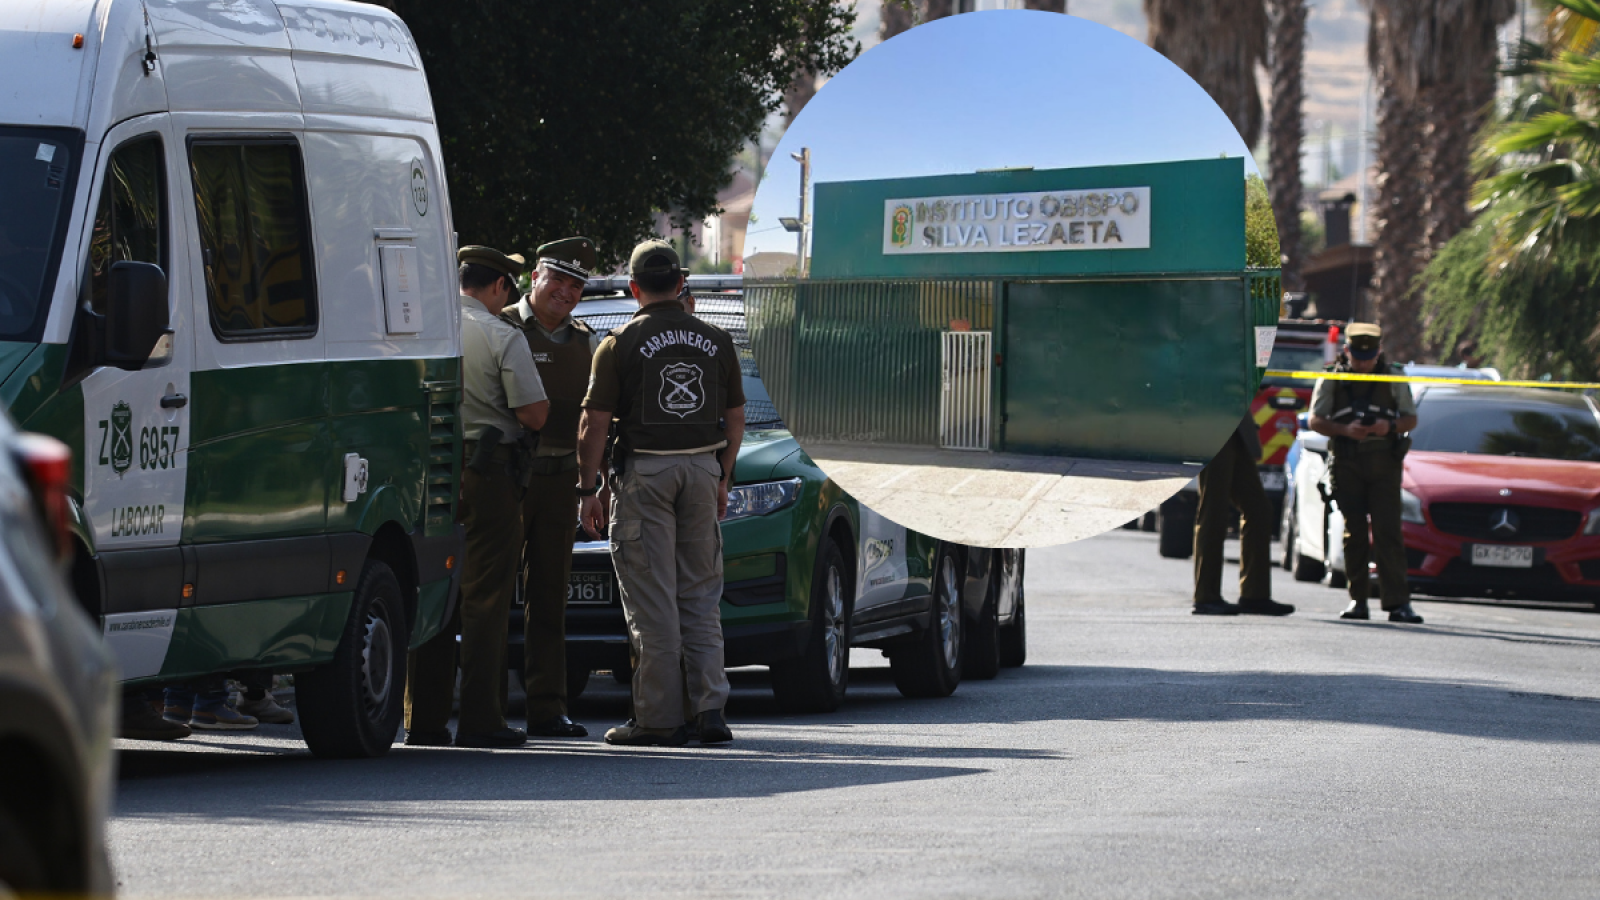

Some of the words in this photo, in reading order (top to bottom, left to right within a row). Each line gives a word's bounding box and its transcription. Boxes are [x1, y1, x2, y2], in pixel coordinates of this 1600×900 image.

[414, 187, 426, 203] 133
[916, 196, 1033, 223] INSTITUTO
[1039, 191, 1140, 218] OBISPO
[922, 223, 990, 249] SILVA
[1000, 220, 1123, 247] LEZAETA
[639, 329, 718, 359] CARABINEROS
[98, 420, 109, 466] Z
[140, 426, 180, 470] 6957
[111, 504, 165, 537] LABOCAR
